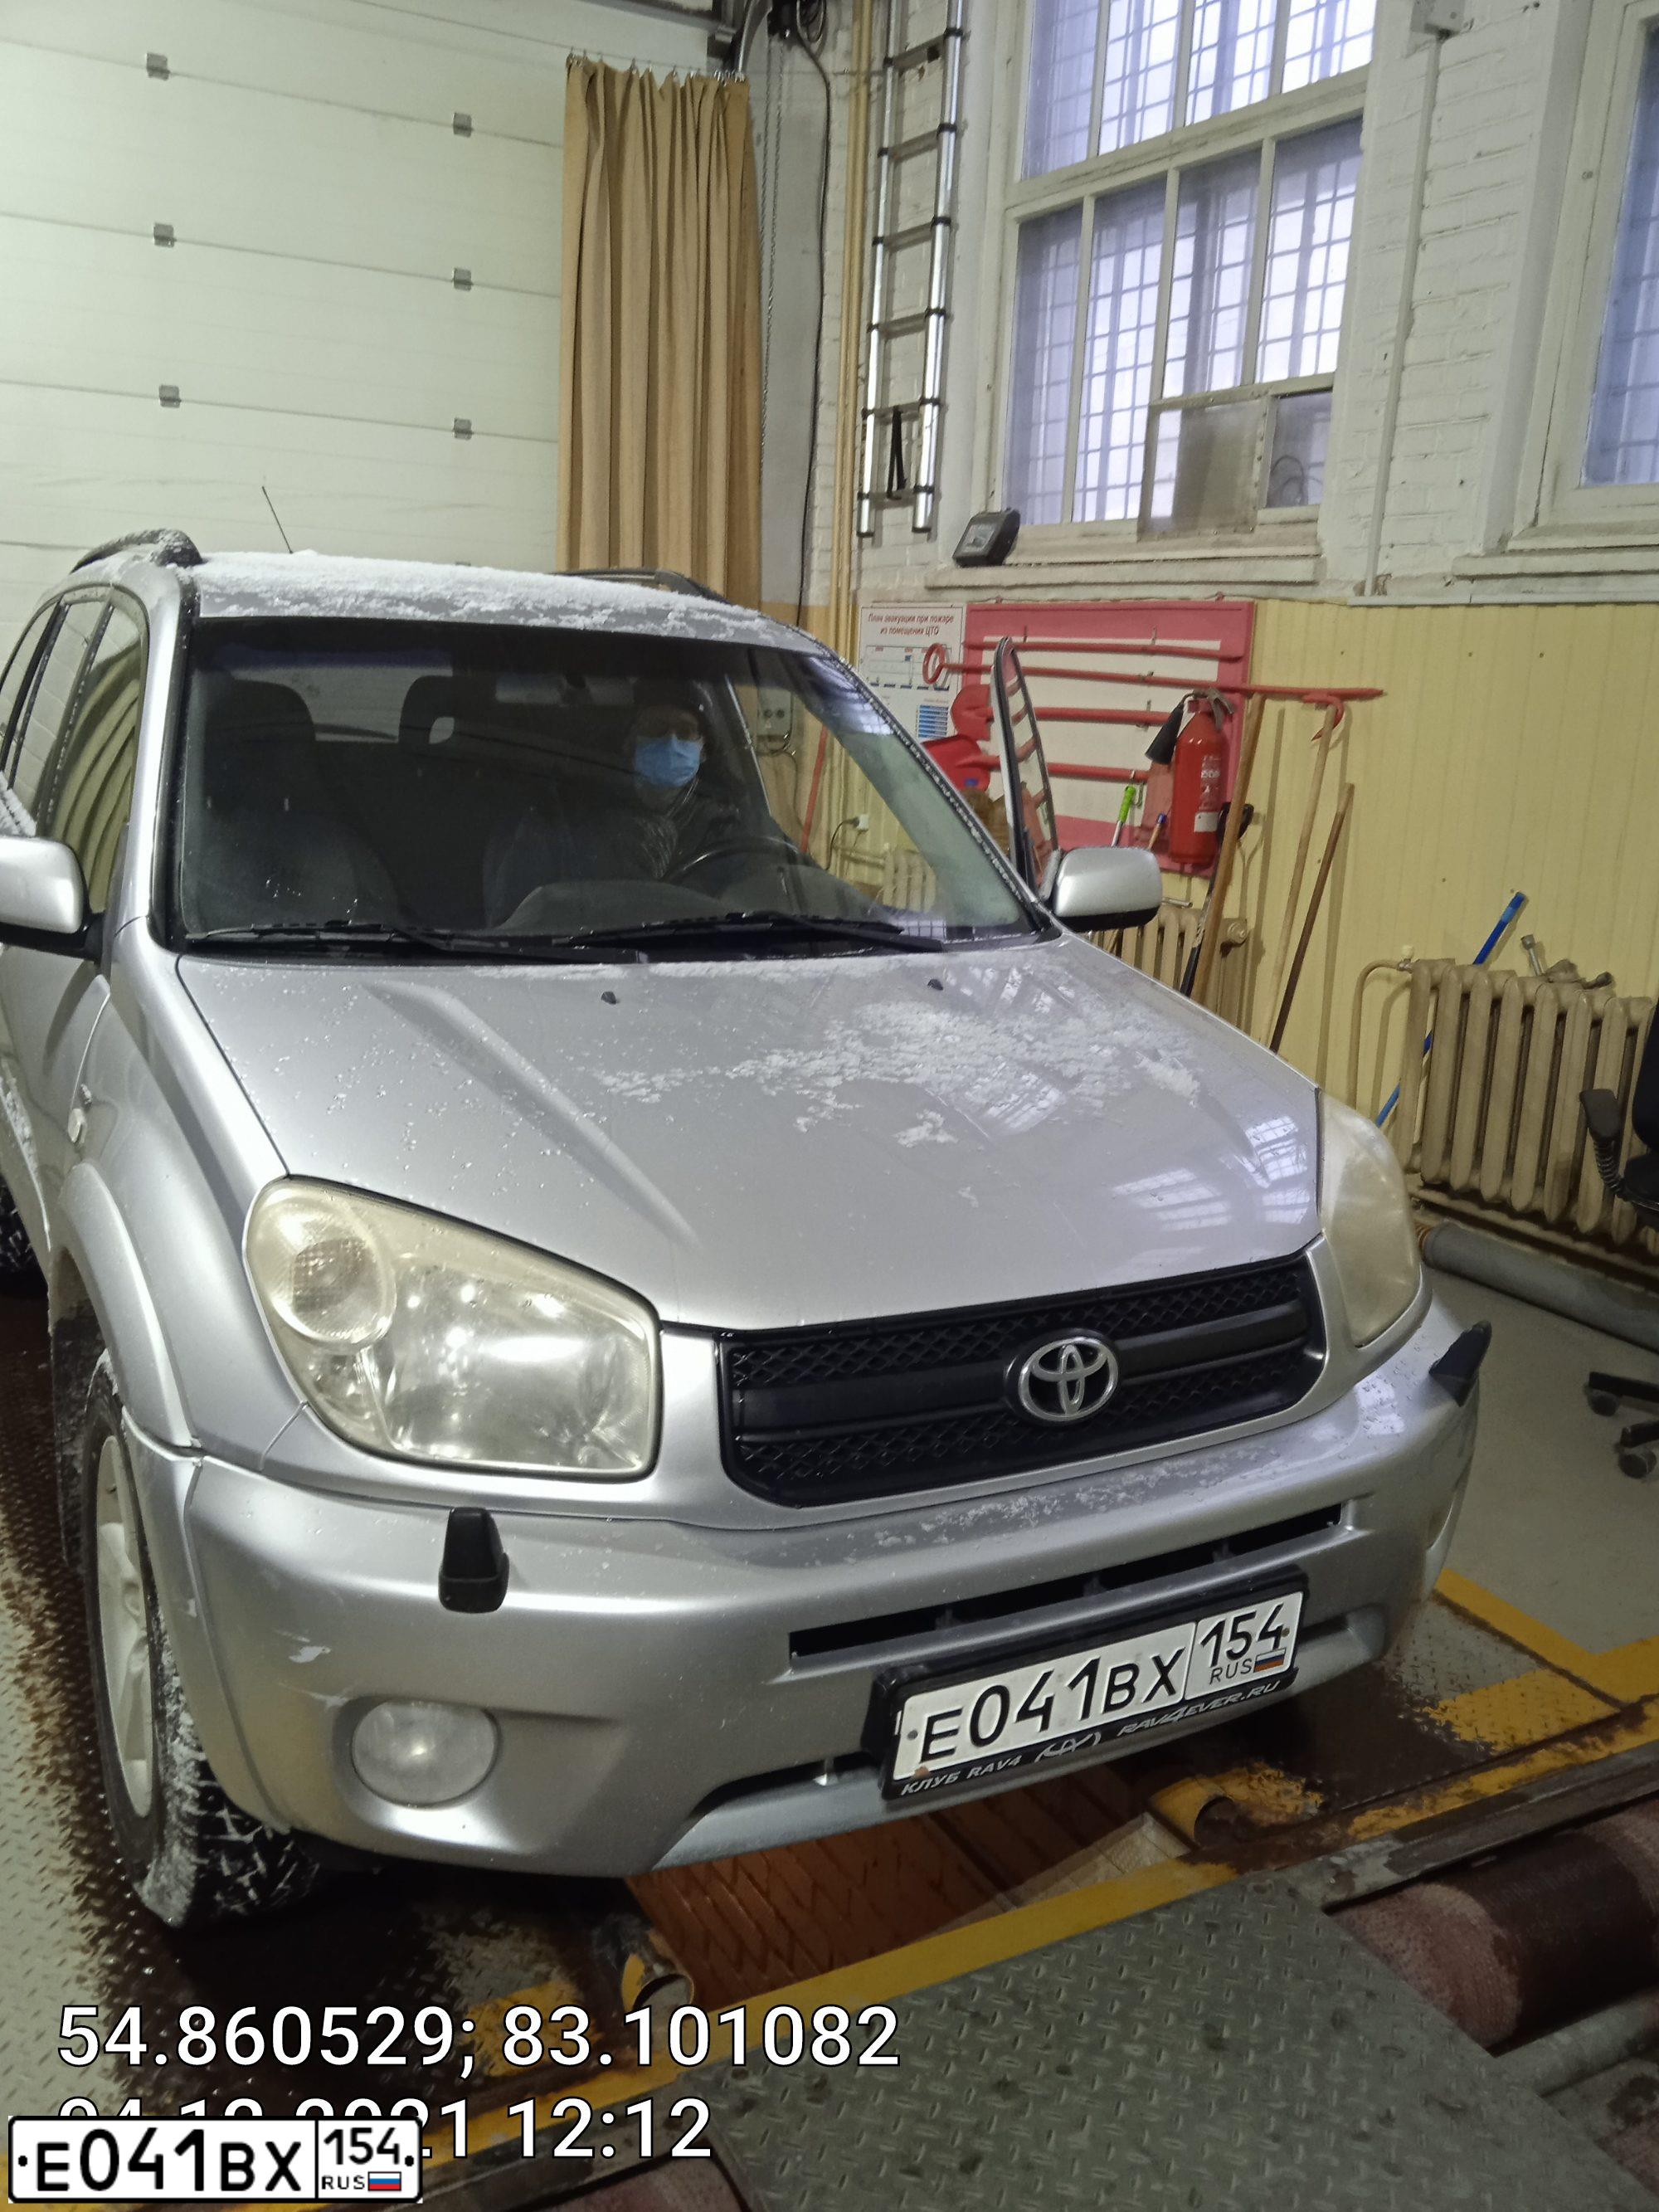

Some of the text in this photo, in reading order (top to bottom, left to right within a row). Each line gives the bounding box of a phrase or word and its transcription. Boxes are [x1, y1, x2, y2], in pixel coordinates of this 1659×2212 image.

[868, 613, 883, 622] План
[917, 615, 928, 624] при
[929, 615, 954, 625] пожаре
[926, 626, 939, 637] ЦТО
[1199, 1601, 1284, 1668] 154
[1209, 1658, 1253, 1685] RUS
[901, 1679, 1281, 1796] КЛУБ RAV4 RAV4EVER.RU
